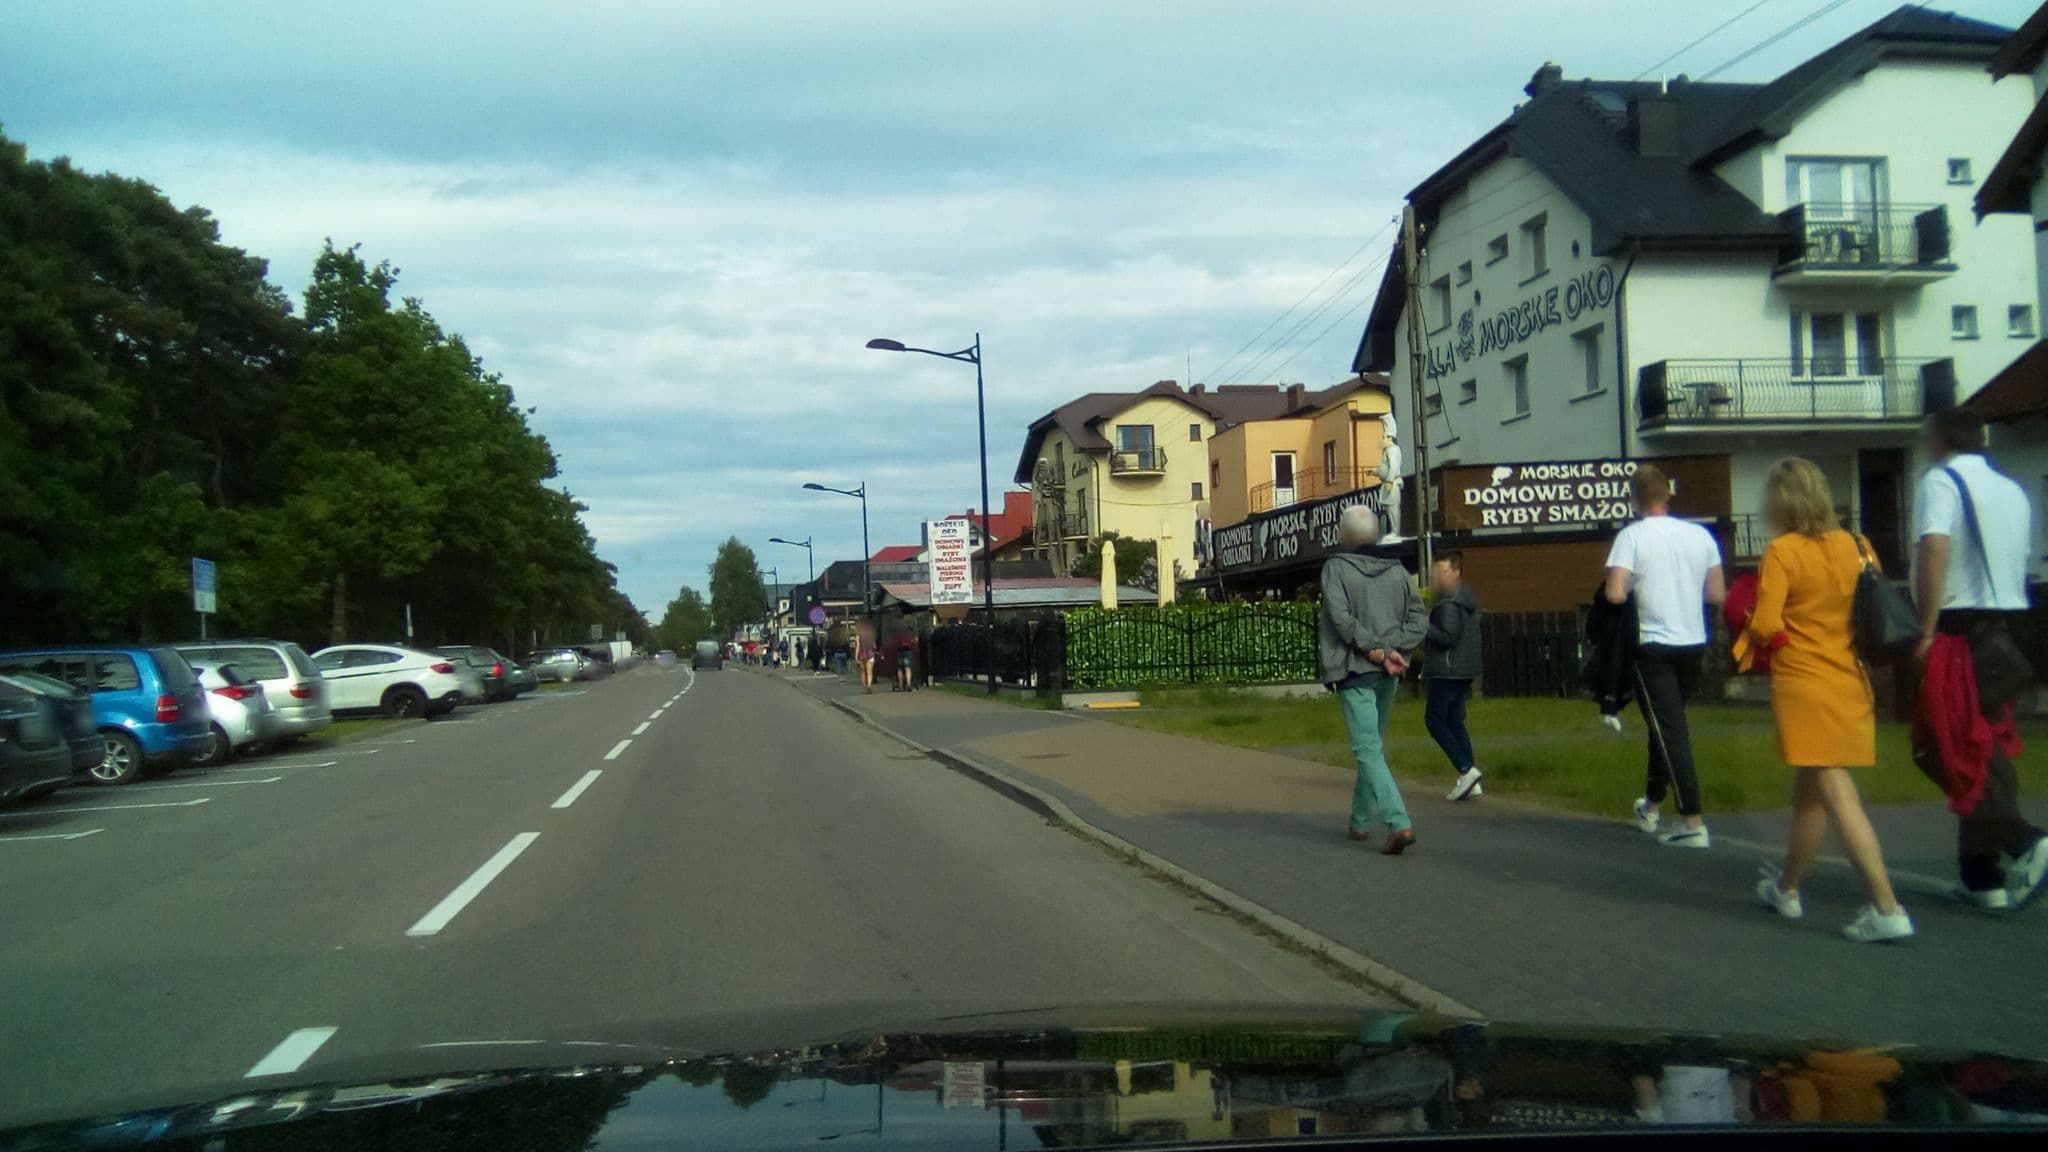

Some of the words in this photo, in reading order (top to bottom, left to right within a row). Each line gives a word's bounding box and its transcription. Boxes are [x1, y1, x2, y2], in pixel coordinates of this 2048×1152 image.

[1564, 264, 1614, 320] OKO
[1520, 463, 1596, 481] MORSKIE
[1600, 461, 1638, 478] OKO
[1464, 484, 1574, 506] DOMOWE
[1312, 501, 1339, 527] RYBY
[1482, 506, 1543, 526] RYBY
[1221, 524, 1253, 549] DOMOWE
[1279, 534, 1298, 557] OKO
